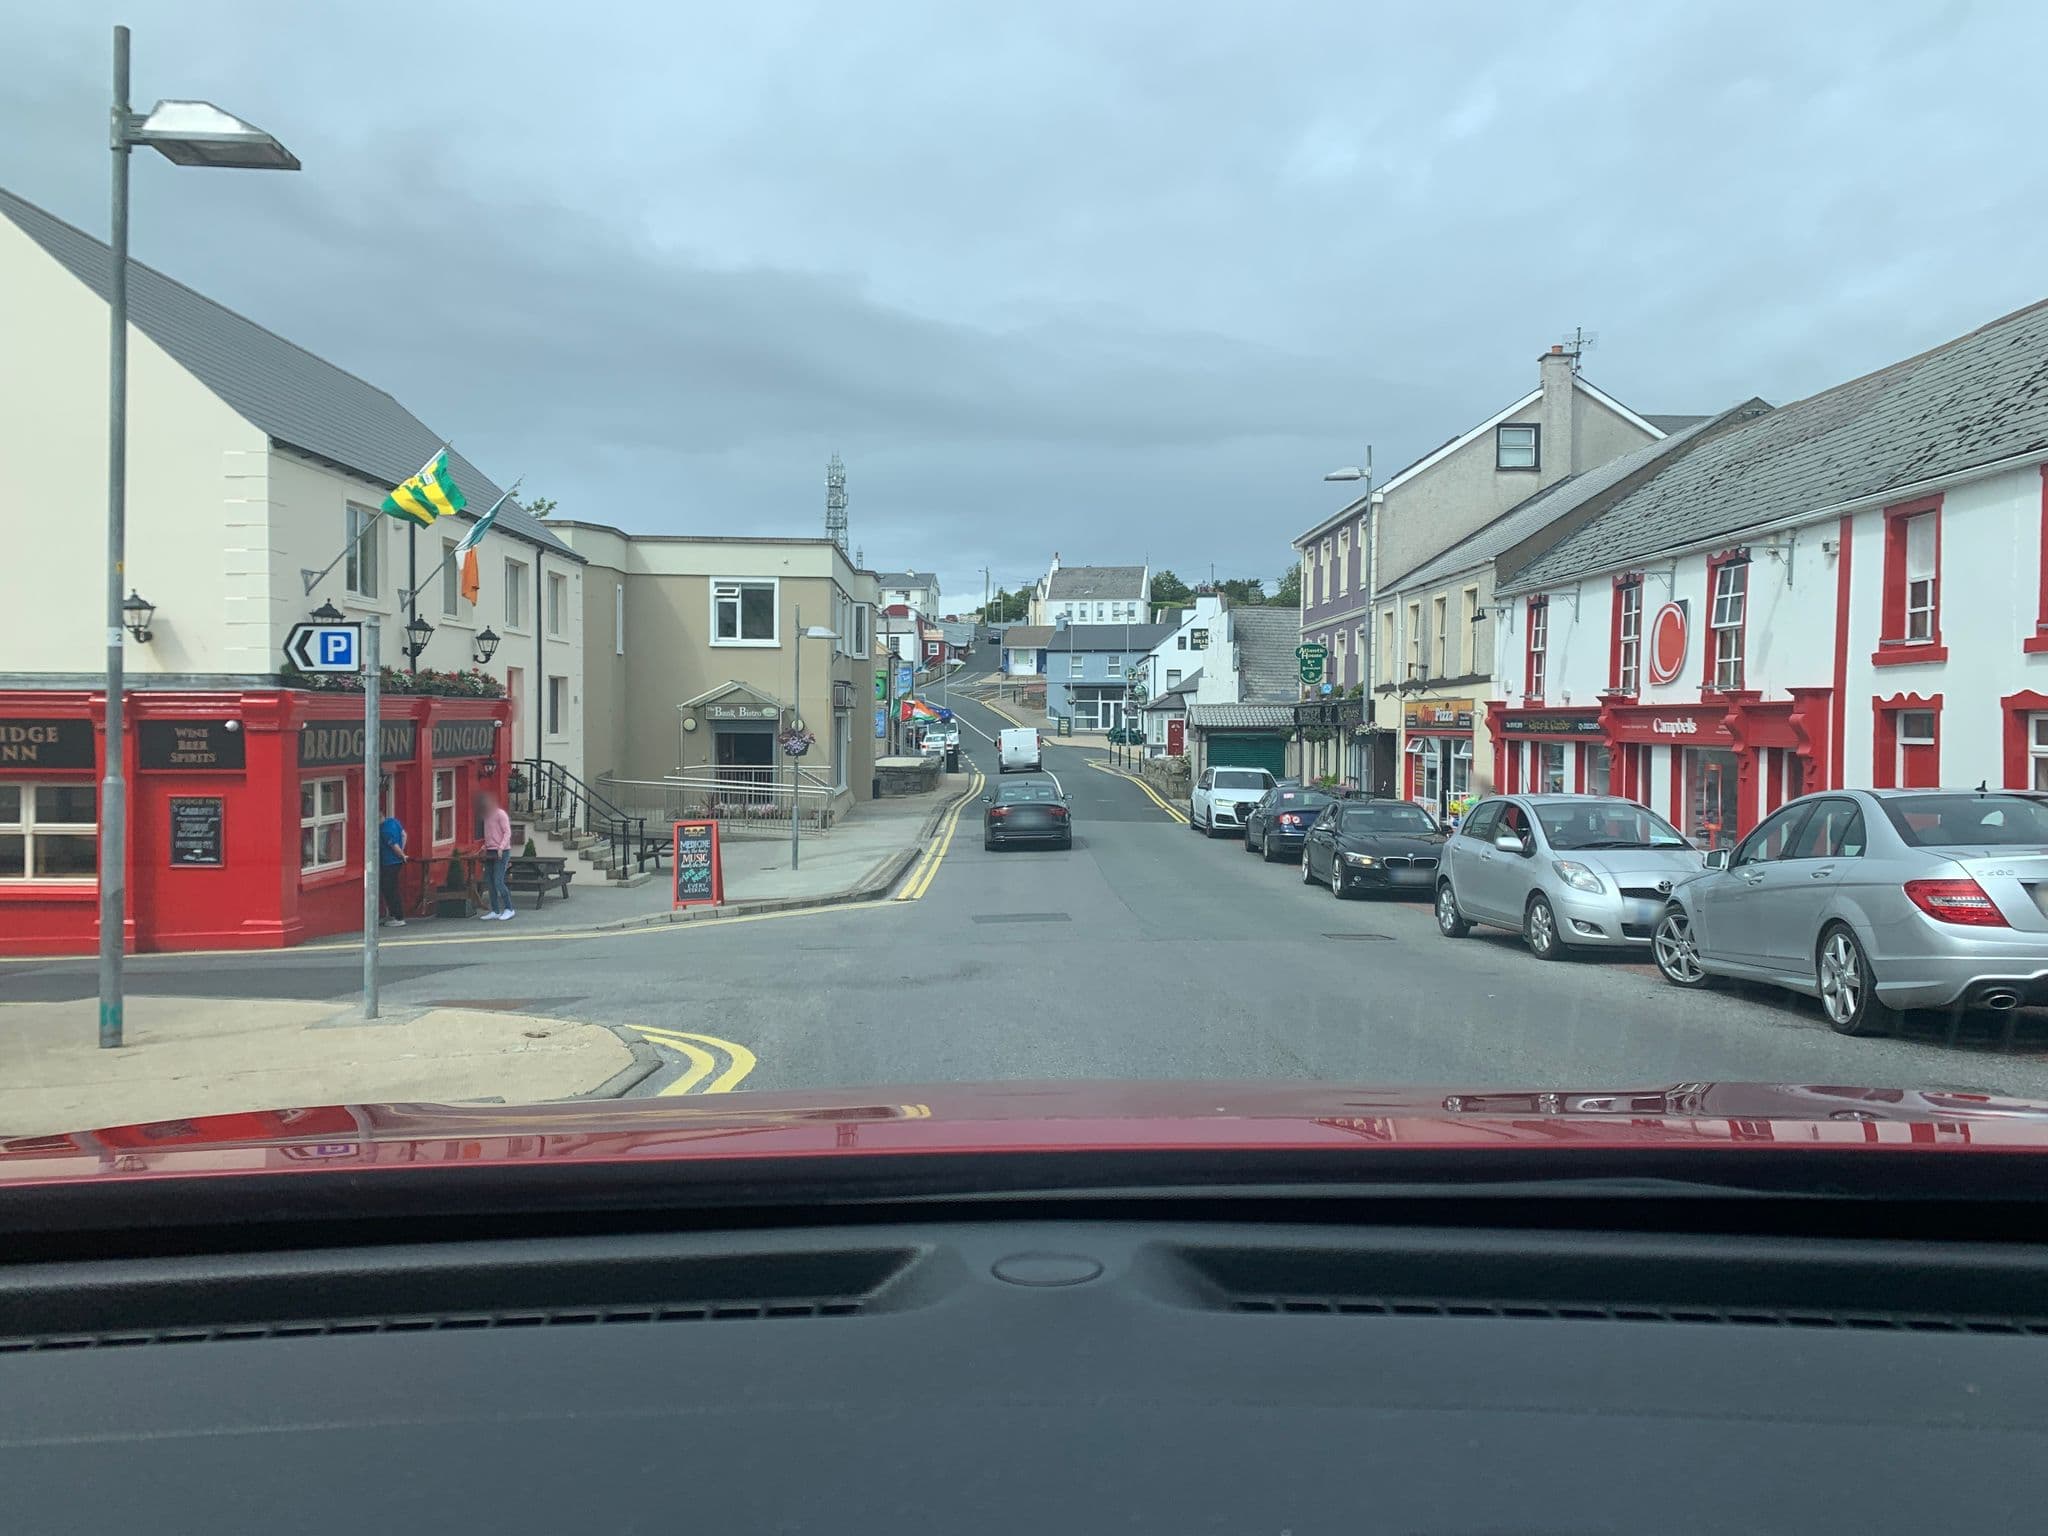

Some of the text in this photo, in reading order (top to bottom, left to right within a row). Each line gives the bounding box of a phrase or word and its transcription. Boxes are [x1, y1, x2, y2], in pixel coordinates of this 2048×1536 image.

[327, 635, 347, 662] P
[1298, 647, 1326, 655] Atlantic
[1301, 652, 1323, 660] House
[714, 706, 736, 718] Bank
[739, 706, 762, 717] Bistro
[1435, 708, 1454, 722] Pizza
[174, 727, 208, 738] WINE
[178, 740, 208, 750] BEER
[303, 728, 365, 760] BRIDG
[380, 726, 411, 757] INN
[169, 752, 216, 763] SPIRITS
[680, 840, 711, 848] MEDICINE
[683, 854, 708, 862] MUSIC
